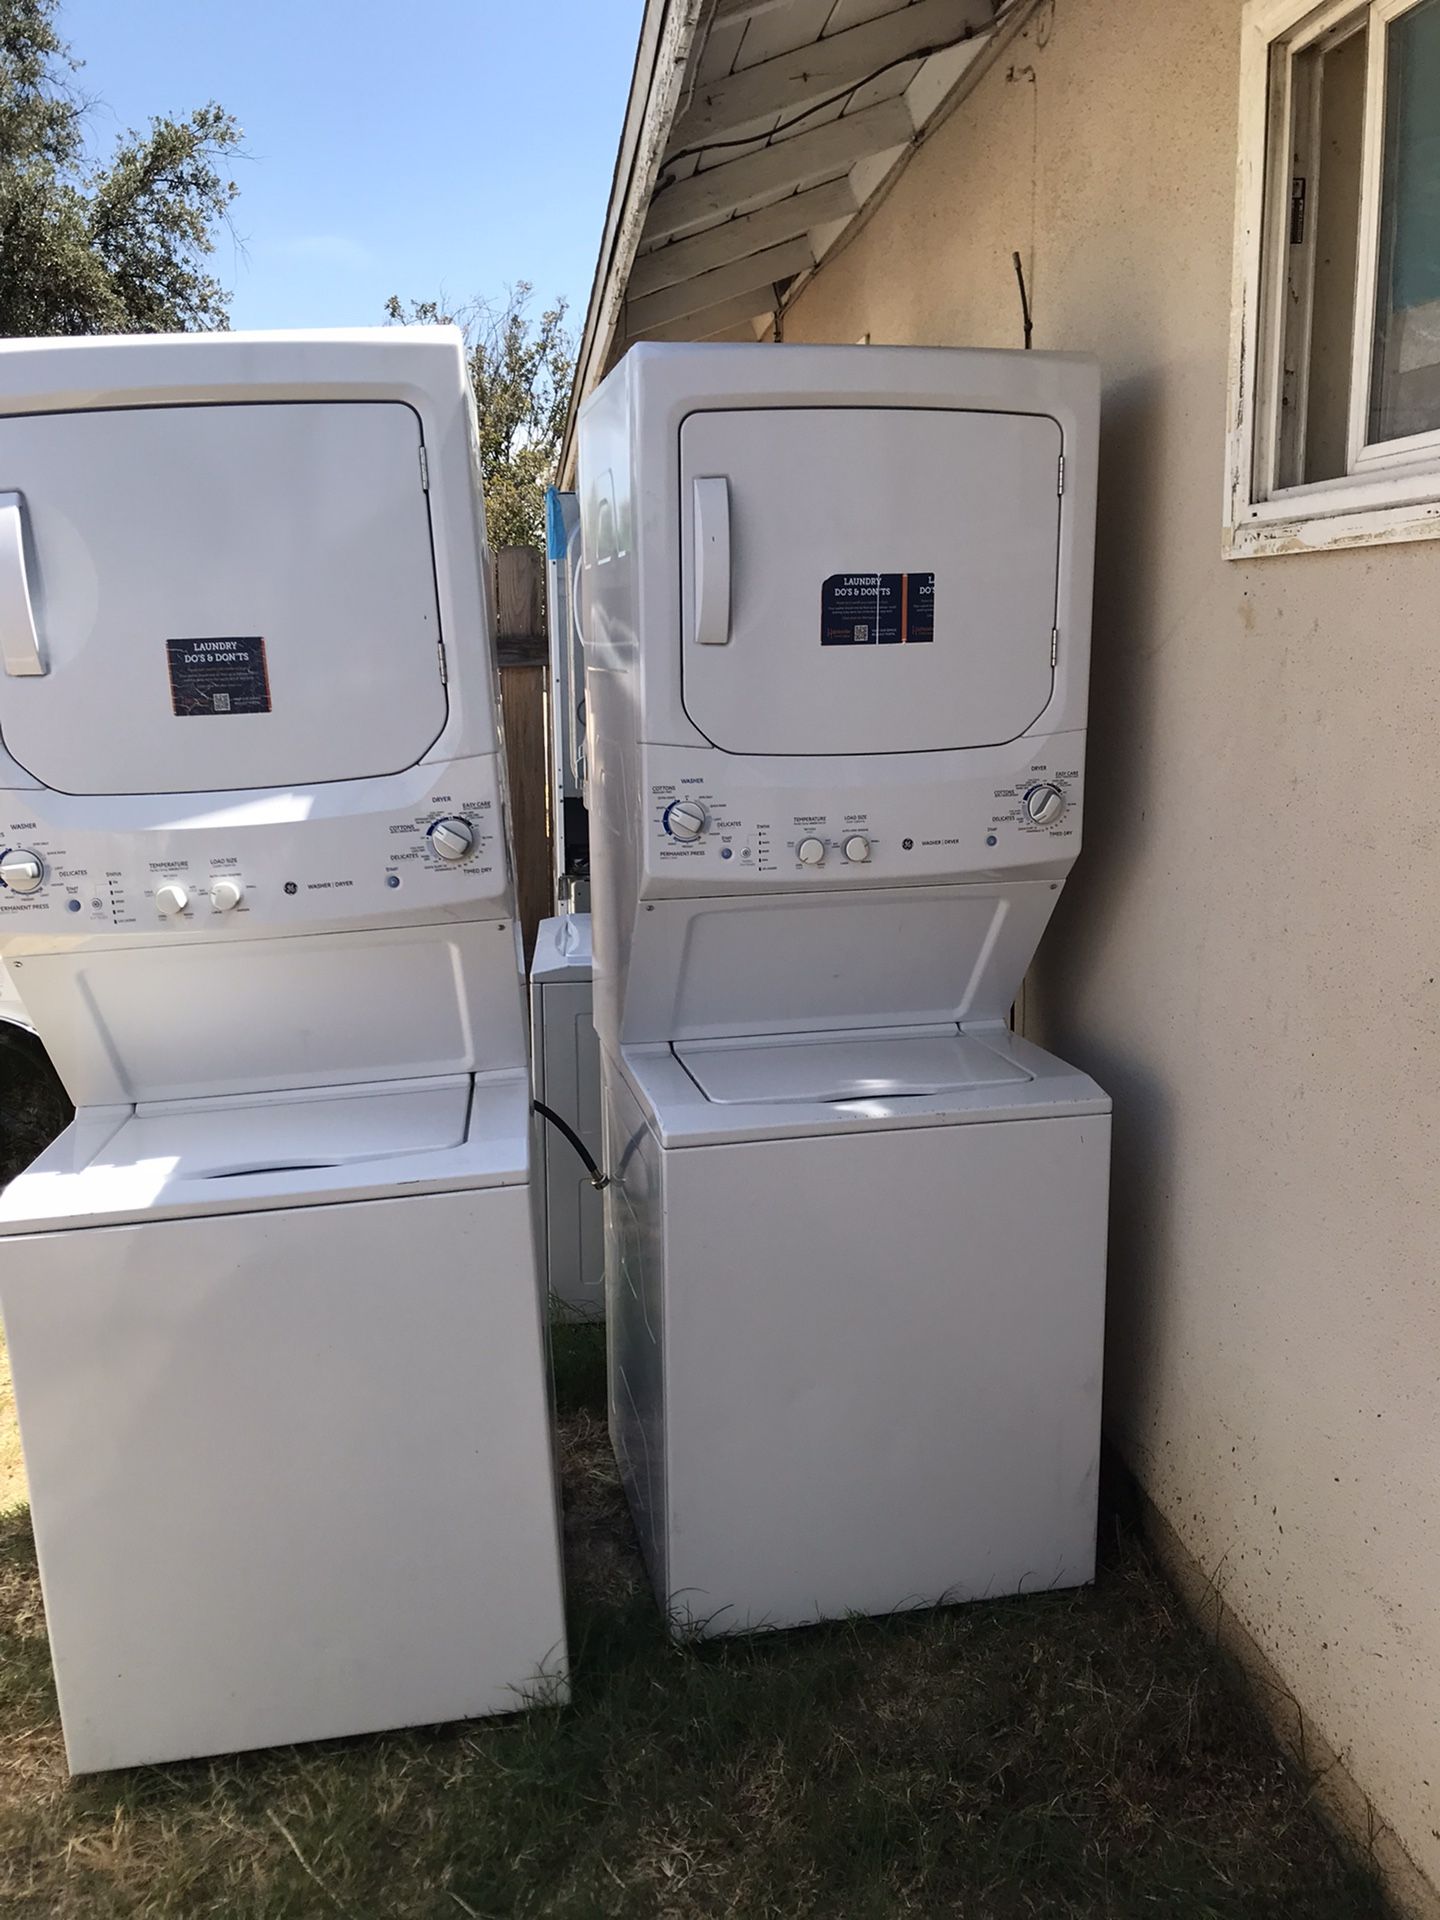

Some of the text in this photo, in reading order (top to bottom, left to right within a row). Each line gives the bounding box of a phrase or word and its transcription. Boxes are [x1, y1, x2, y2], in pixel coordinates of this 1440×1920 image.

[844, 577, 882, 586] LAUNDRY
[194, 642, 237, 651] LAUNDRY
[184, 654, 206, 663] DO'S
[207, 653, 214, 661] &
[10, 822, 37, 830] WASHER
[59, 869, 88, 877] DELICATES
